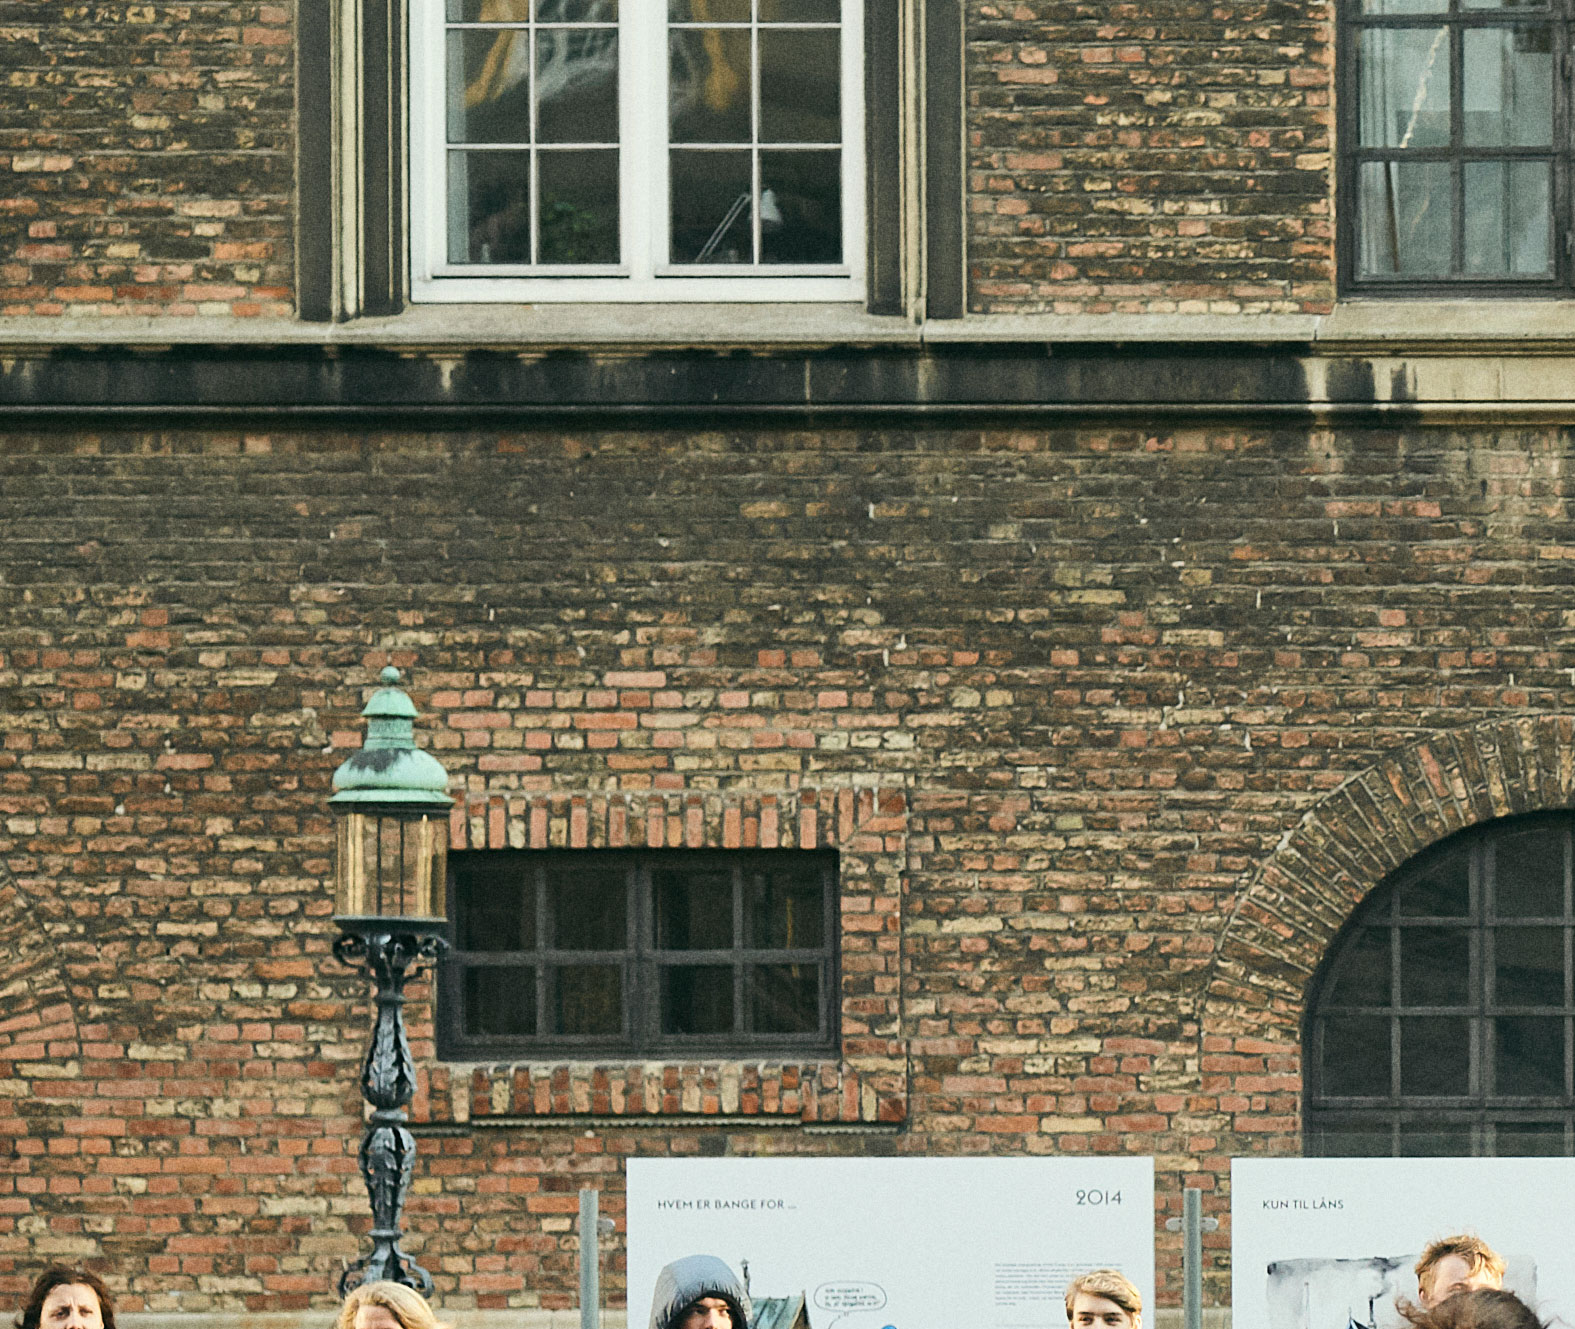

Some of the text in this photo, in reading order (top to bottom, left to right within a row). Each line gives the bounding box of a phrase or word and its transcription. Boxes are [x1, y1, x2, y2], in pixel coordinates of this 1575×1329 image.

[657, 1199, 693, 1209] HVEM
[697, 1199, 710, 1209] ER
[714, 1199, 757, 1209] BANGE
[760, 1199, 784, 1209] FOR
[1075, 1189, 1122, 1205] 2014
[1262, 1195, 1344, 1209] KUN TIL LÅNS
